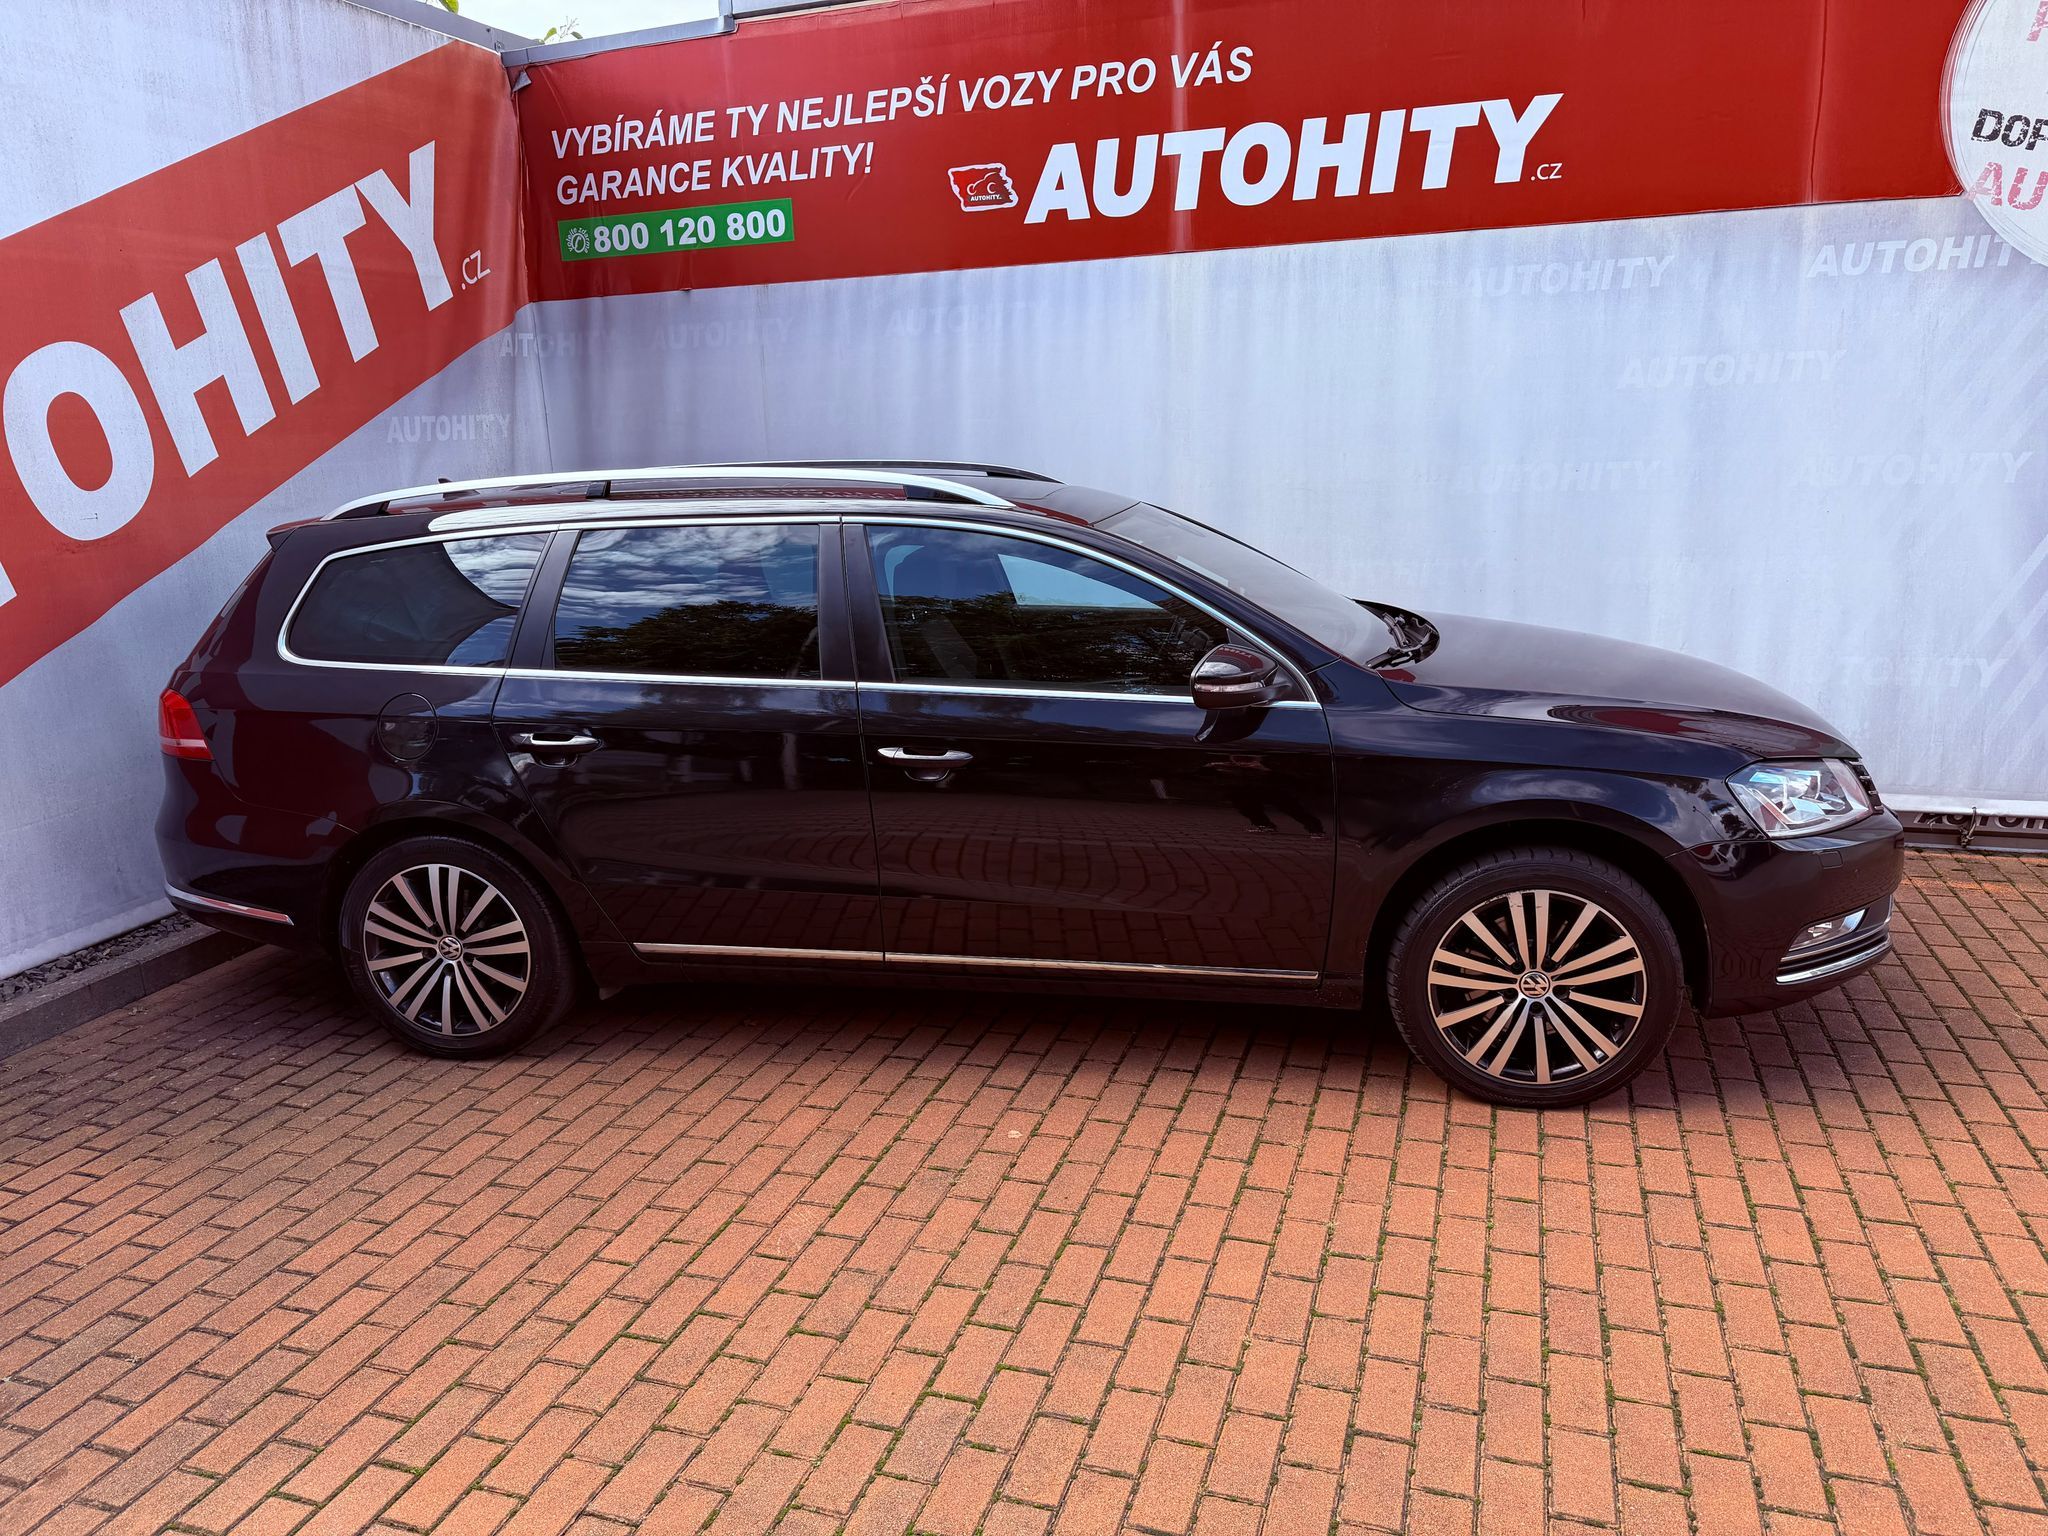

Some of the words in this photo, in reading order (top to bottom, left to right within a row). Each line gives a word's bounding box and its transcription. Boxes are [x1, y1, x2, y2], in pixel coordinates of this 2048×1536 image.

[551, 109, 716, 160] VYBÍRÁME
[726, 103, 770, 139] TY
[776, 74, 950, 134] NEJLEPŠÍ
[958, 68, 1064, 112] VOZY
[1070, 57, 1158, 101] PRO
[1170, 40, 1254, 90] VÁS
[556, 158, 713, 206] GARANCE
[721, 140, 875, 189] KVALITY!
[1023, 92, 1564, 226] AUTOHITY
[593, 222, 650, 253] 800
[659, 215, 717, 246] 120
[726, 208, 787, 241] 800
[1807, 234, 2046, 278] AUTOHIT
[0, 140, 454, 608] OHITY
[386, 412, 511, 444] AUTOHITY
